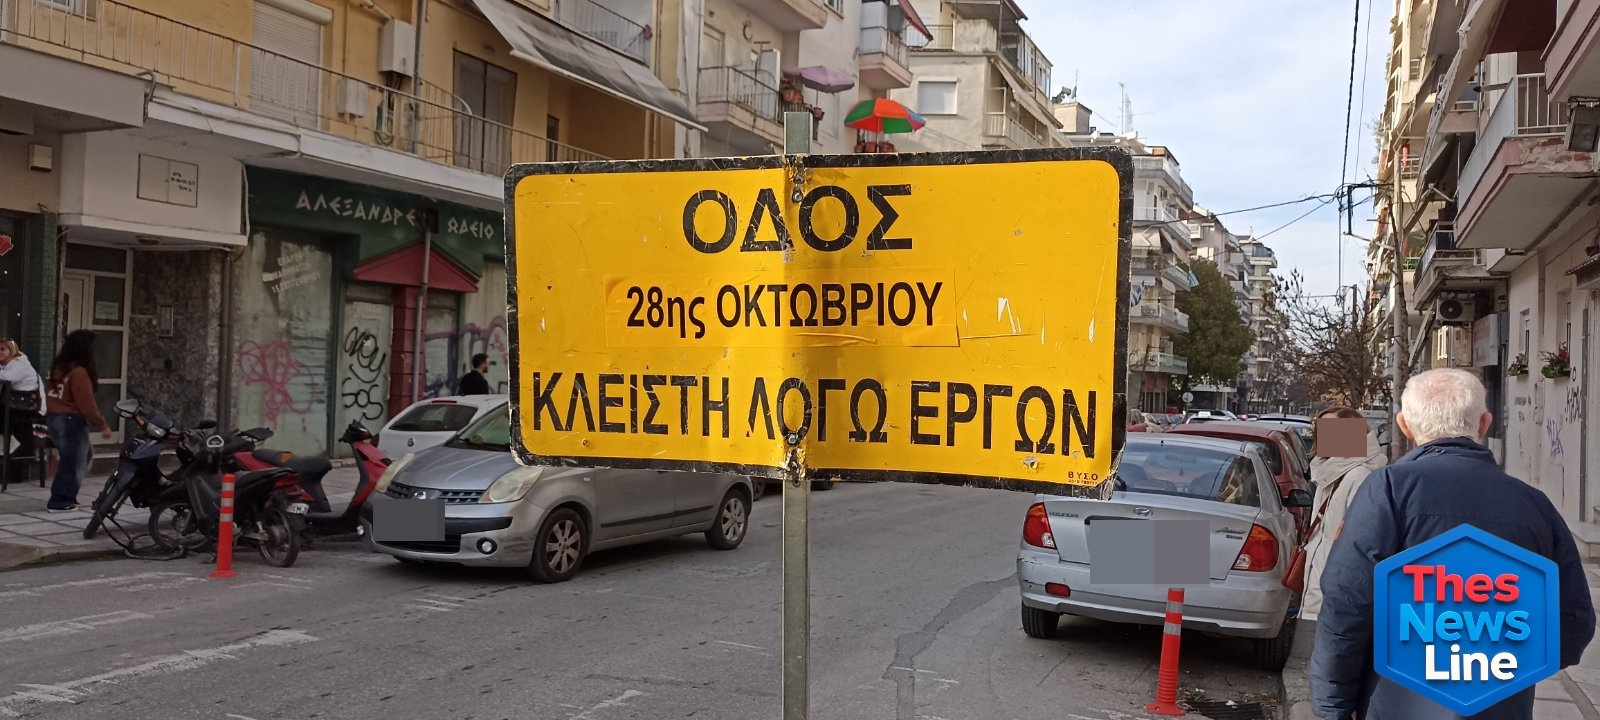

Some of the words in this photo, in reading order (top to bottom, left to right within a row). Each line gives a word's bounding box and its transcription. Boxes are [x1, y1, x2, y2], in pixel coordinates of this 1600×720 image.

[296, 190, 432, 229] ΑΛΕΞΑΝΔΡΕ
[447, 216, 496, 240] ΩΔΕΙΟ
[682, 184, 912, 254] ΟΔΟΣ
[626, 286, 706, 339] 28ης
[716, 282, 943, 328] ΟΚΤΩΒΡΙΟΥ
[532, 371, 730, 438] ΚΛΕΙΣΤΗ
[745, 377, 888, 444] ΛΟΓΩ
[910, 380, 1097, 459] ΕΡΓΩΝ
